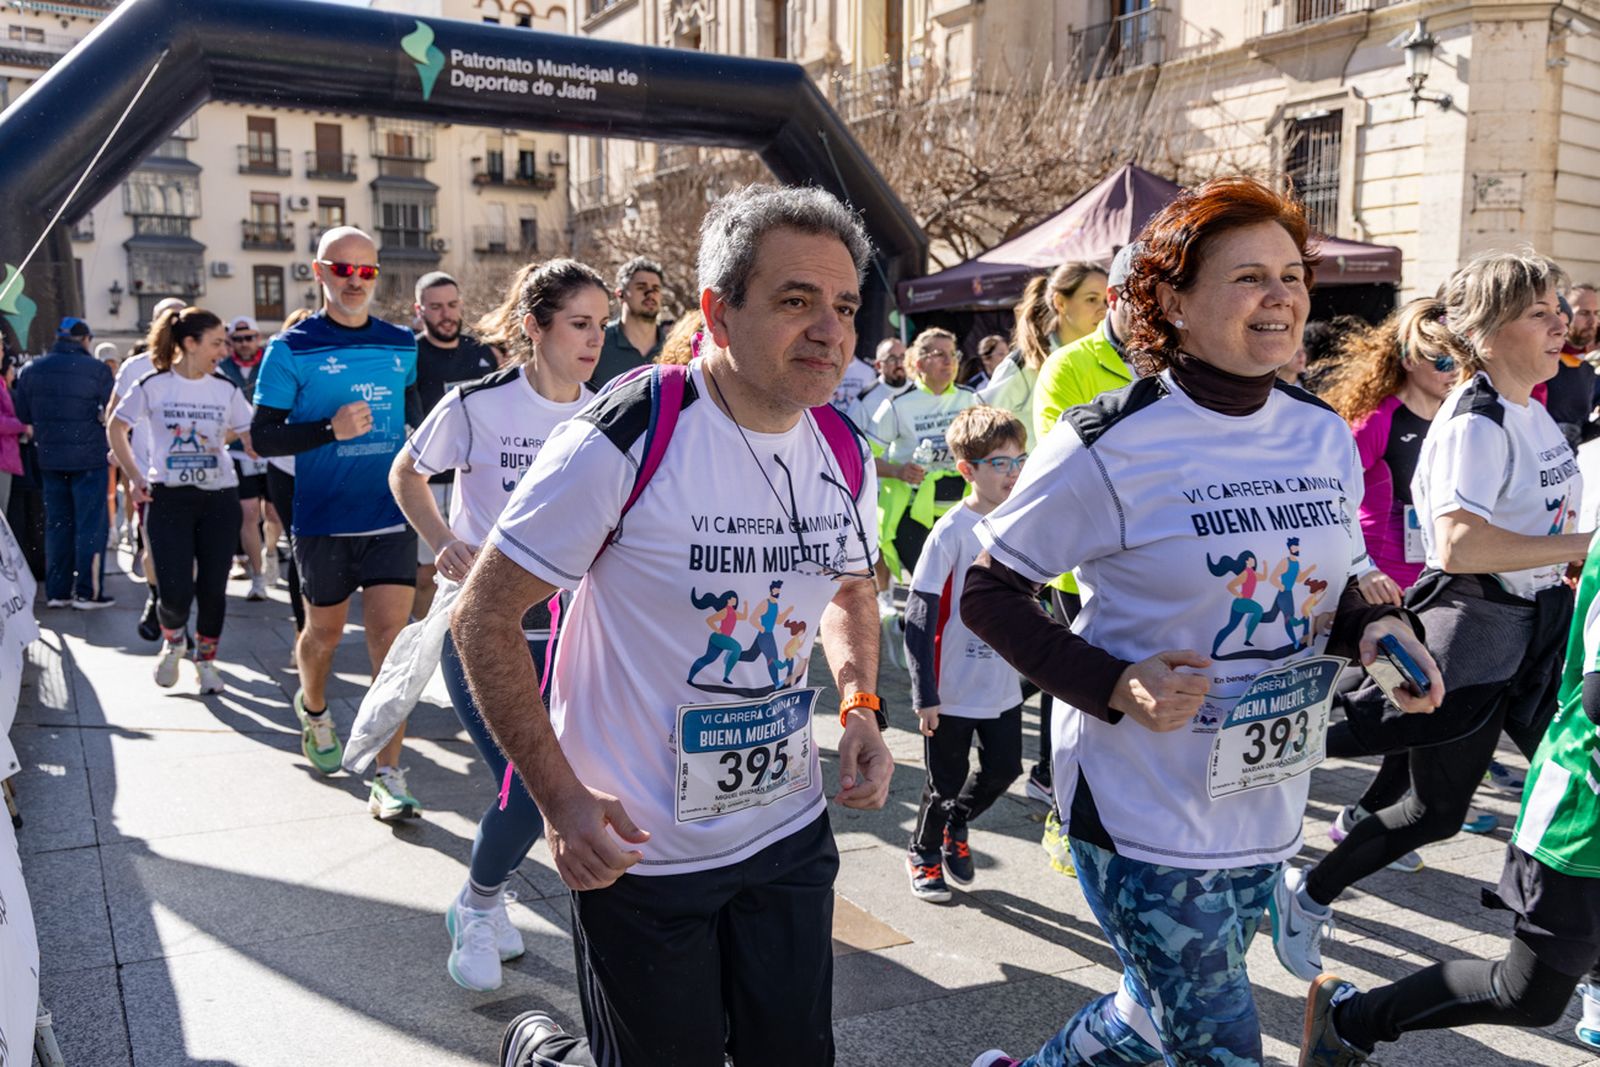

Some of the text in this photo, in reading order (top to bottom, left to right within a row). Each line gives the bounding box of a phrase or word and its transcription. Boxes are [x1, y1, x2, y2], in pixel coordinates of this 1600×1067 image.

[451, 49, 638, 86] Patronato Municipal de
[451, 69, 596, 100] Deportes de Jaén
[500, 436, 545, 448] VI CARR
[932, 449, 954, 462] 27
[179, 469, 206, 482] 610
[1183, 488, 1204, 504] VI
[1207, 480, 1285, 500] CARRERA
[691, 512, 852, 534] VI CARRERA CAMINATA
[1191, 500, 1340, 537] BUENA MUERTE
[689, 544, 756, 573] BUENA
[1288, 666, 1322, 686] CAMINATA
[701, 695, 800, 724] VI CARRERA CAMINATA
[1232, 698, 1267, 721] BUENA
[1270, 687, 1305, 714] MUERTE
[700, 728, 742, 747] BUENA
[746, 718, 786, 743] MUERTE
[1243, 710, 1308, 765] 393
[717, 738, 789, 793] 395
